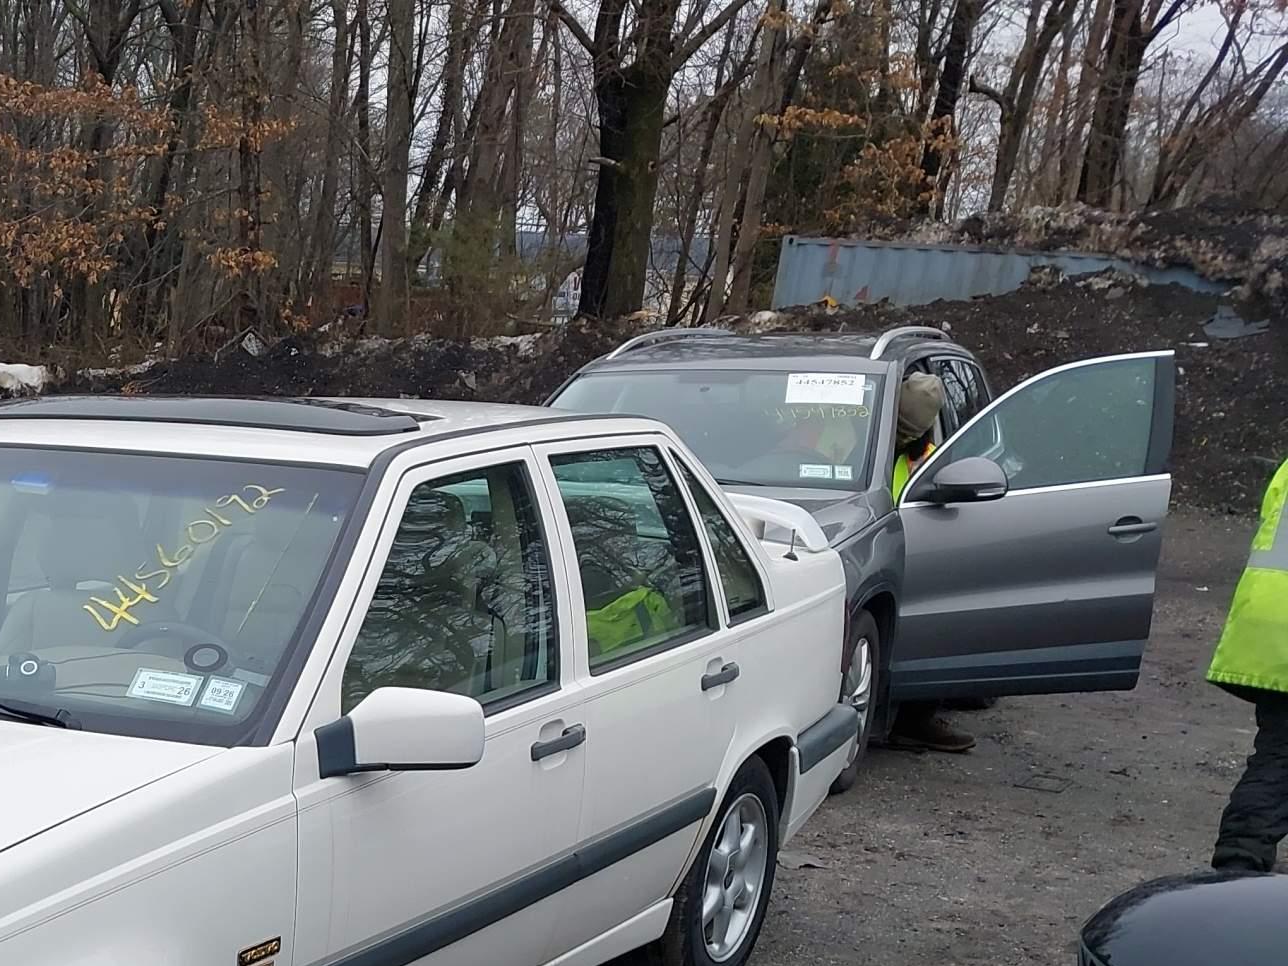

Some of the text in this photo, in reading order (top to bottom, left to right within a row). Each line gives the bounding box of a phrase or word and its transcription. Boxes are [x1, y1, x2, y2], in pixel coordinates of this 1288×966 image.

[82, 484, 286, 632] 44560192
[137, 680, 146, 690] 3
[176, 686, 191, 697] 26
